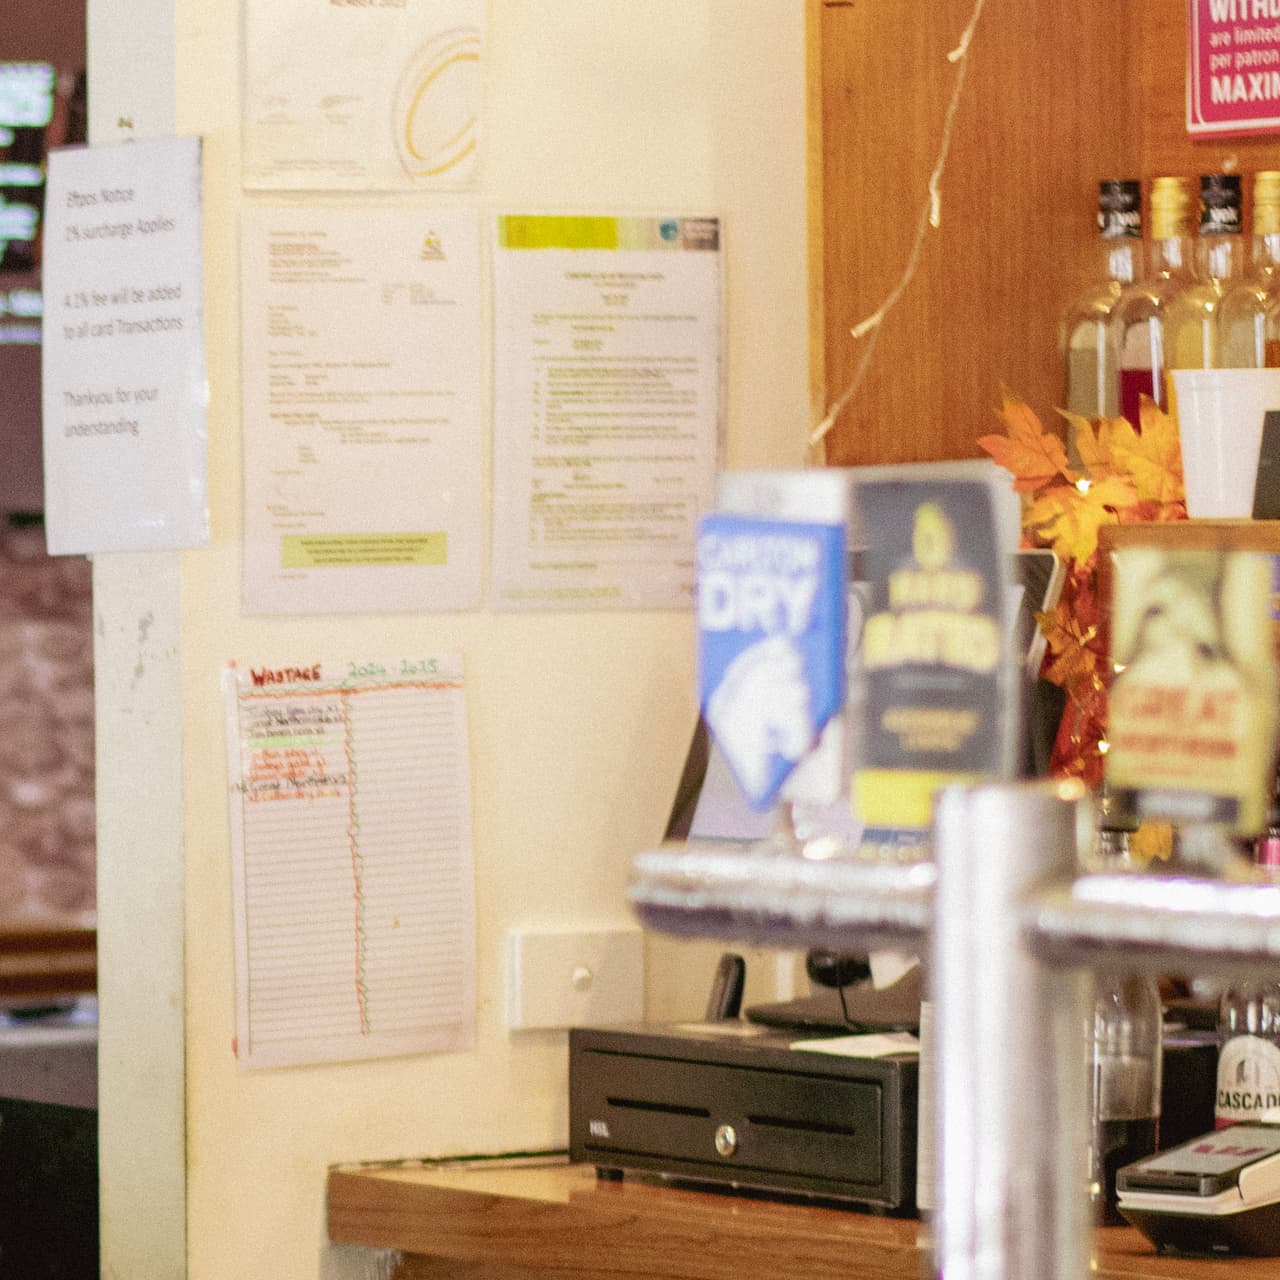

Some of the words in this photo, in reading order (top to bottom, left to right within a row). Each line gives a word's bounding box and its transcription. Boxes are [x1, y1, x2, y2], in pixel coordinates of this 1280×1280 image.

[1209, 0, 1280, 23] WITHD
[1209, 31, 1231, 48] are
[1209, 53, 1231, 74] per
[1233, 48, 1280, 72] patron
[82, 223, 133, 240] surcharge
[137, 218, 175, 234] Applies
[112, 288, 129, 304] will
[132, 288, 145, 303] be
[147, 285, 181, 301] added
[64, 326, 74, 339] to
[77, 323, 89, 337] all
[91, 324, 113, 337] card
[116, 318, 183, 334] Transactions
[115, 387, 130, 402] for
[133, 389, 159, 404] your
[64, 420, 139, 438] understanding
[701, 571, 815, 632] DRY
[250, 663, 321, 687] WASTAGE
[1218, 1090, 1280, 1111] CASCAD
